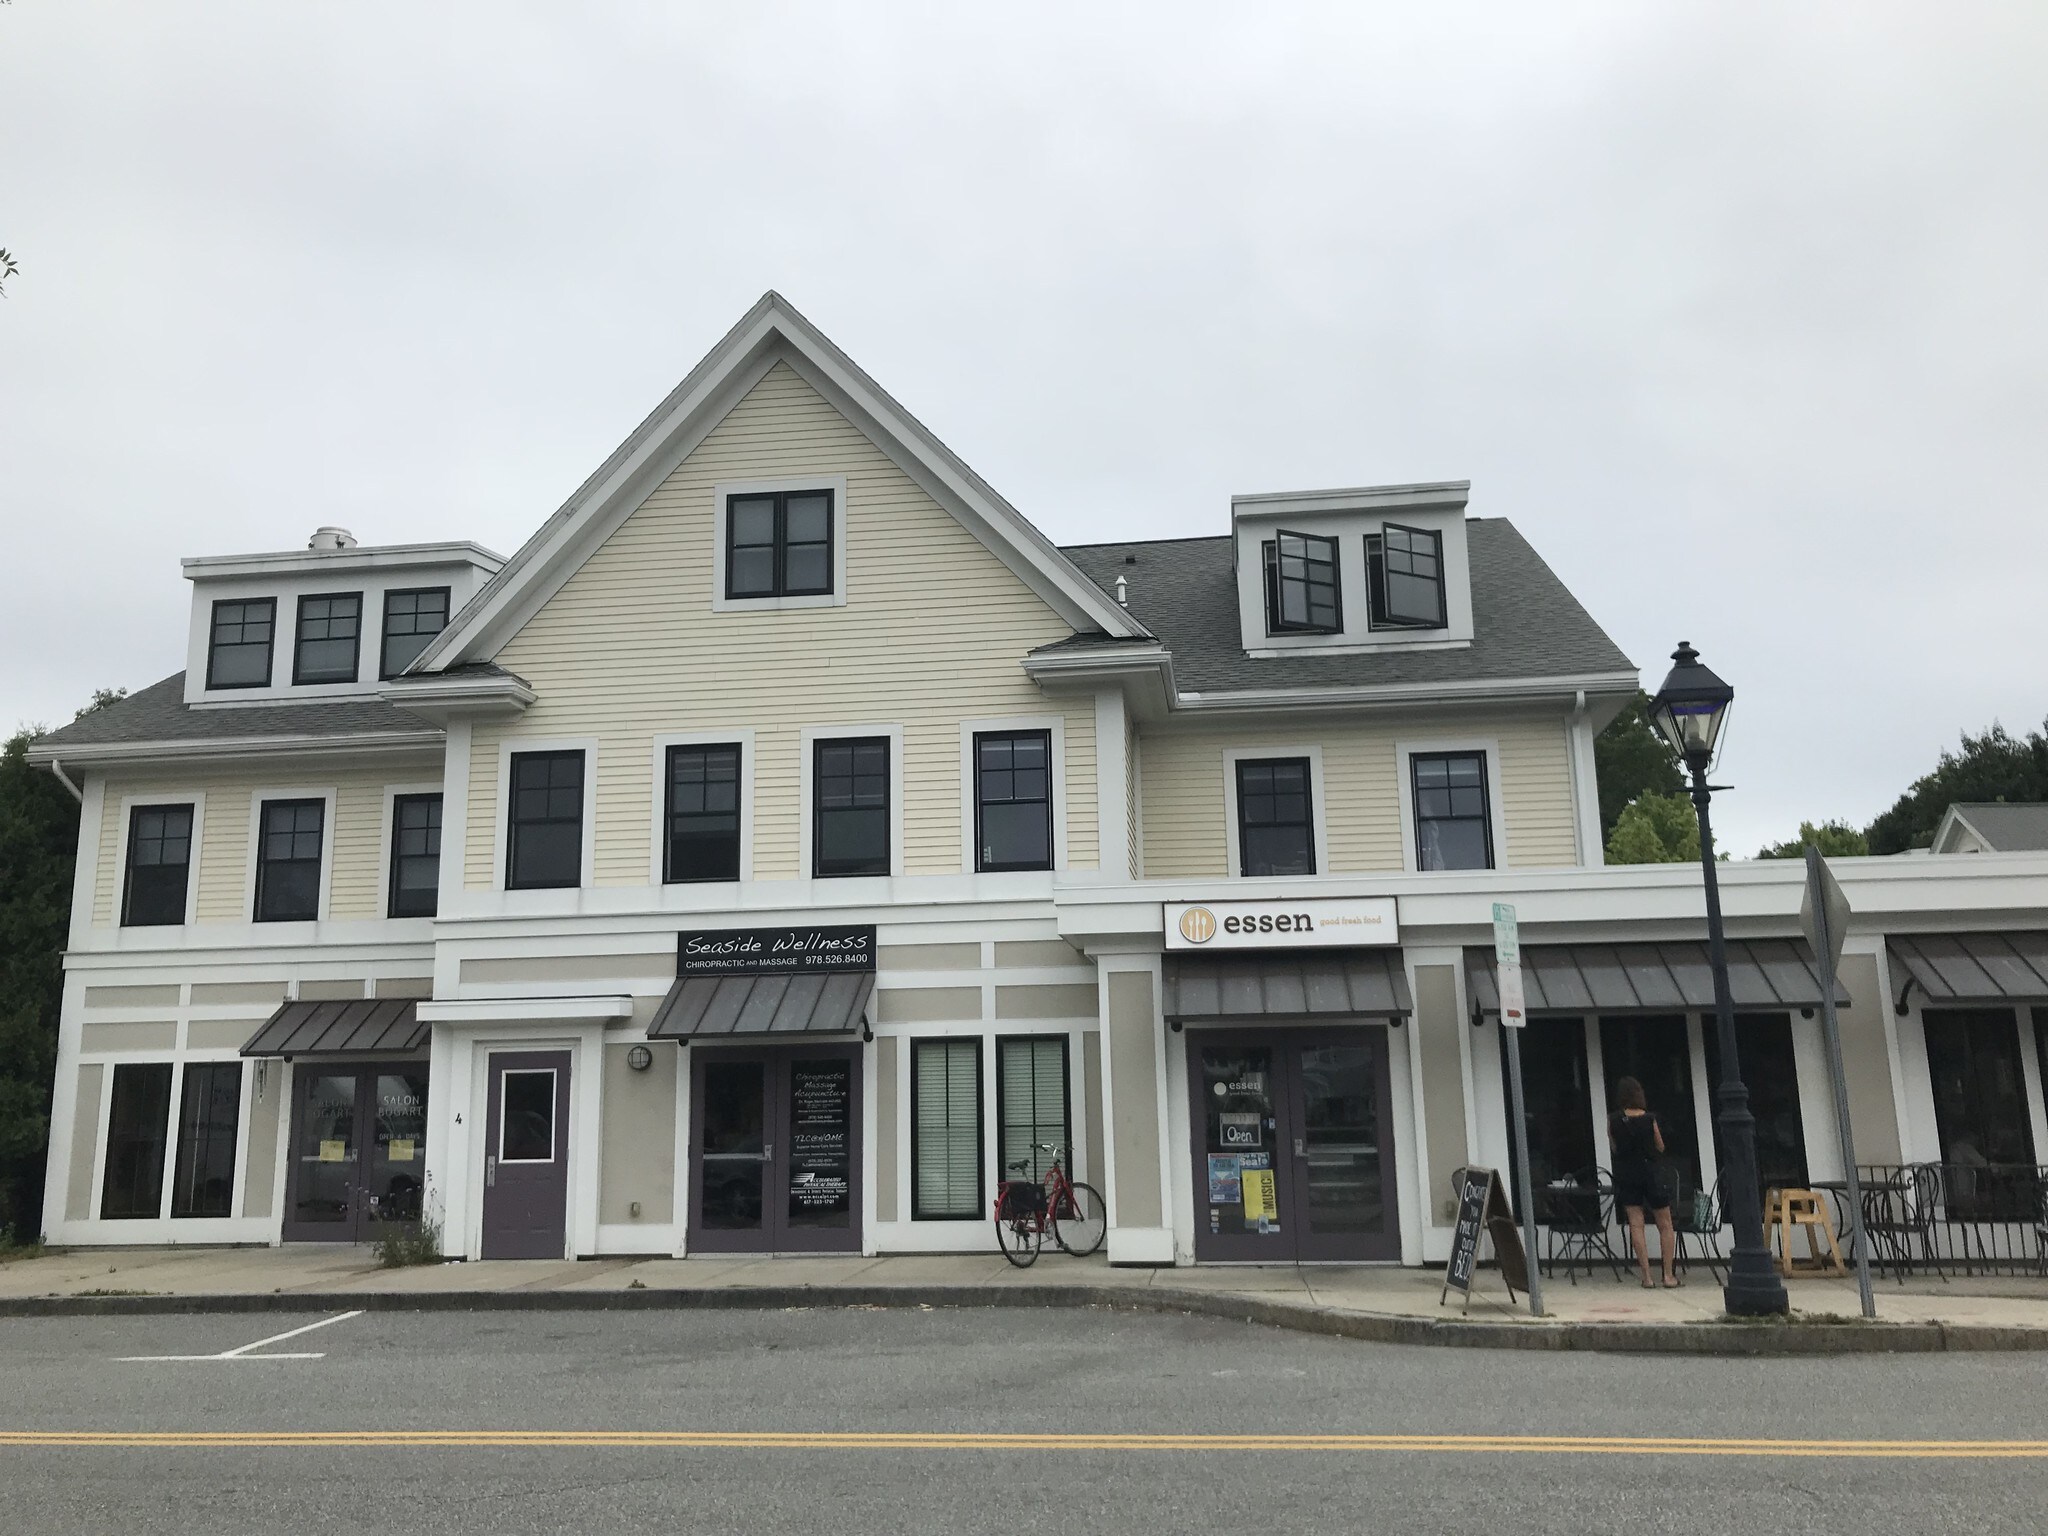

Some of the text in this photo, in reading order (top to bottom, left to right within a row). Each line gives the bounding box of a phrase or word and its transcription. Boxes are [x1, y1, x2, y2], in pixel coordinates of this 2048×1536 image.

[1223, 913, 1382, 933] essen good fresh food
[686, 932, 868, 954] Seaside Wellness
[686, 959, 745, 969] CHIROPRACTIC
[759, 957, 798, 966] MASSAGE
[805, 954, 868, 965] 978.526.8400
[796, 1073, 845, 1081] Chiropractic
[804, 1081, 837, 1090] Massage
[1229, 1082, 1261, 1090] essen
[383, 1095, 420, 1105] SALON
[378, 1106, 423, 1117] BOGART
[455, 1112, 462, 1124] 4
[1227, 1126, 1253, 1142] Open
[1261, 1178, 1275, 1210] MUSIC
